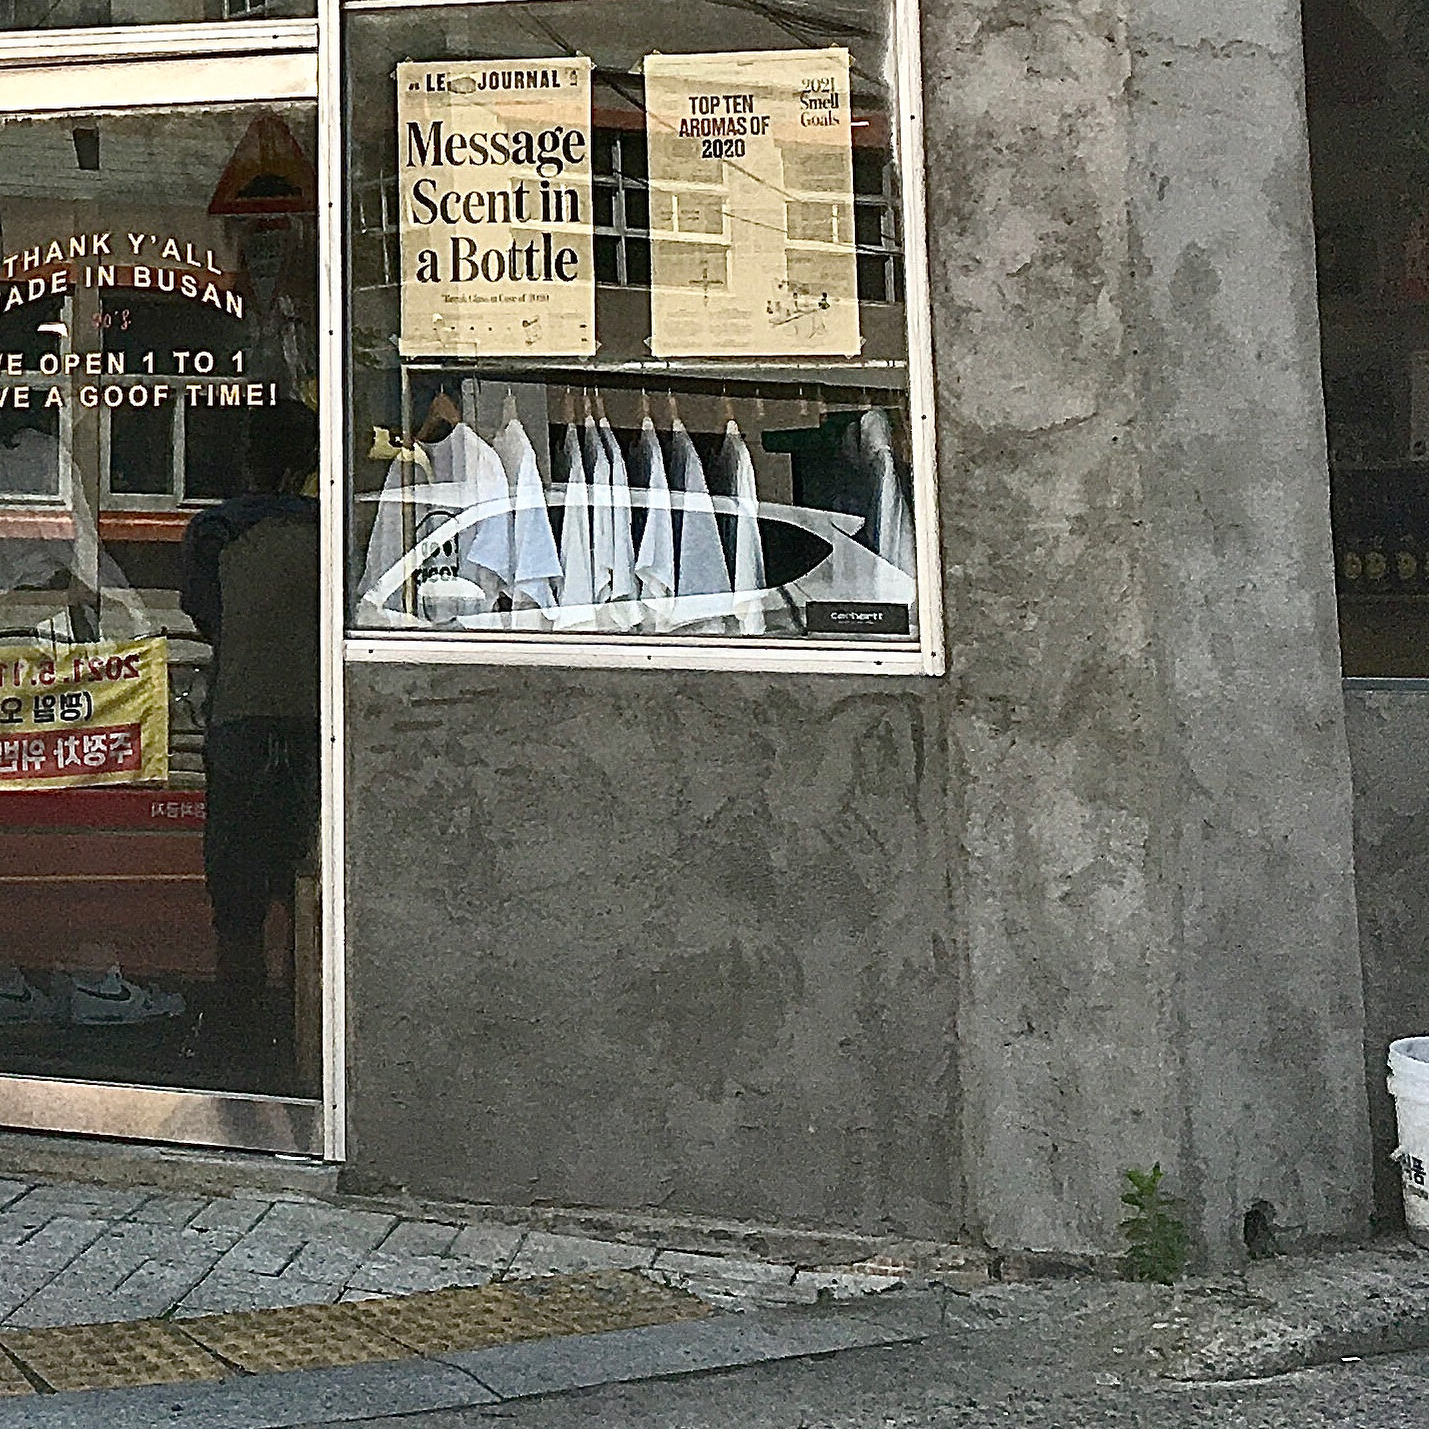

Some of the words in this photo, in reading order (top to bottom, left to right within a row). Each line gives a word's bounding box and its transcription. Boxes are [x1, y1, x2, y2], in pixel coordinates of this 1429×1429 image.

[478, 70, 560, 90] JOURNAL
[802, 77, 835, 93] 2021
[689, 96, 720, 115] TOP
[722, 94, 754, 114] TEN
[800, 91, 839, 110] Smell
[679, 117, 747, 138] AROMAS
[750, 115, 770, 135] OF
[800, 110, 840, 127] Goals
[406, 121, 585, 178] Message
[702, 139, 746, 158] 2020
[412, 178, 531, 224] Scent
[540, 180, 580, 223] in
[3, 233, 111, 279] THANK
[128, 232, 223, 275] Y'ALL
[416, 248, 441, 283] a
[450, 232, 579, 283] Bottle
[85, 264, 116, 288] IN
[133, 265, 243, 320] BUSAN
[39, 352, 125, 375] OPEN
[142, 352, 153, 373] 1
[173, 350, 214, 373] TO
[231, 350, 243, 372] 1
[45, 385, 65, 407] A
[80, 384, 169, 408] GOOF
[186, 383, 277, 407] TIME!
